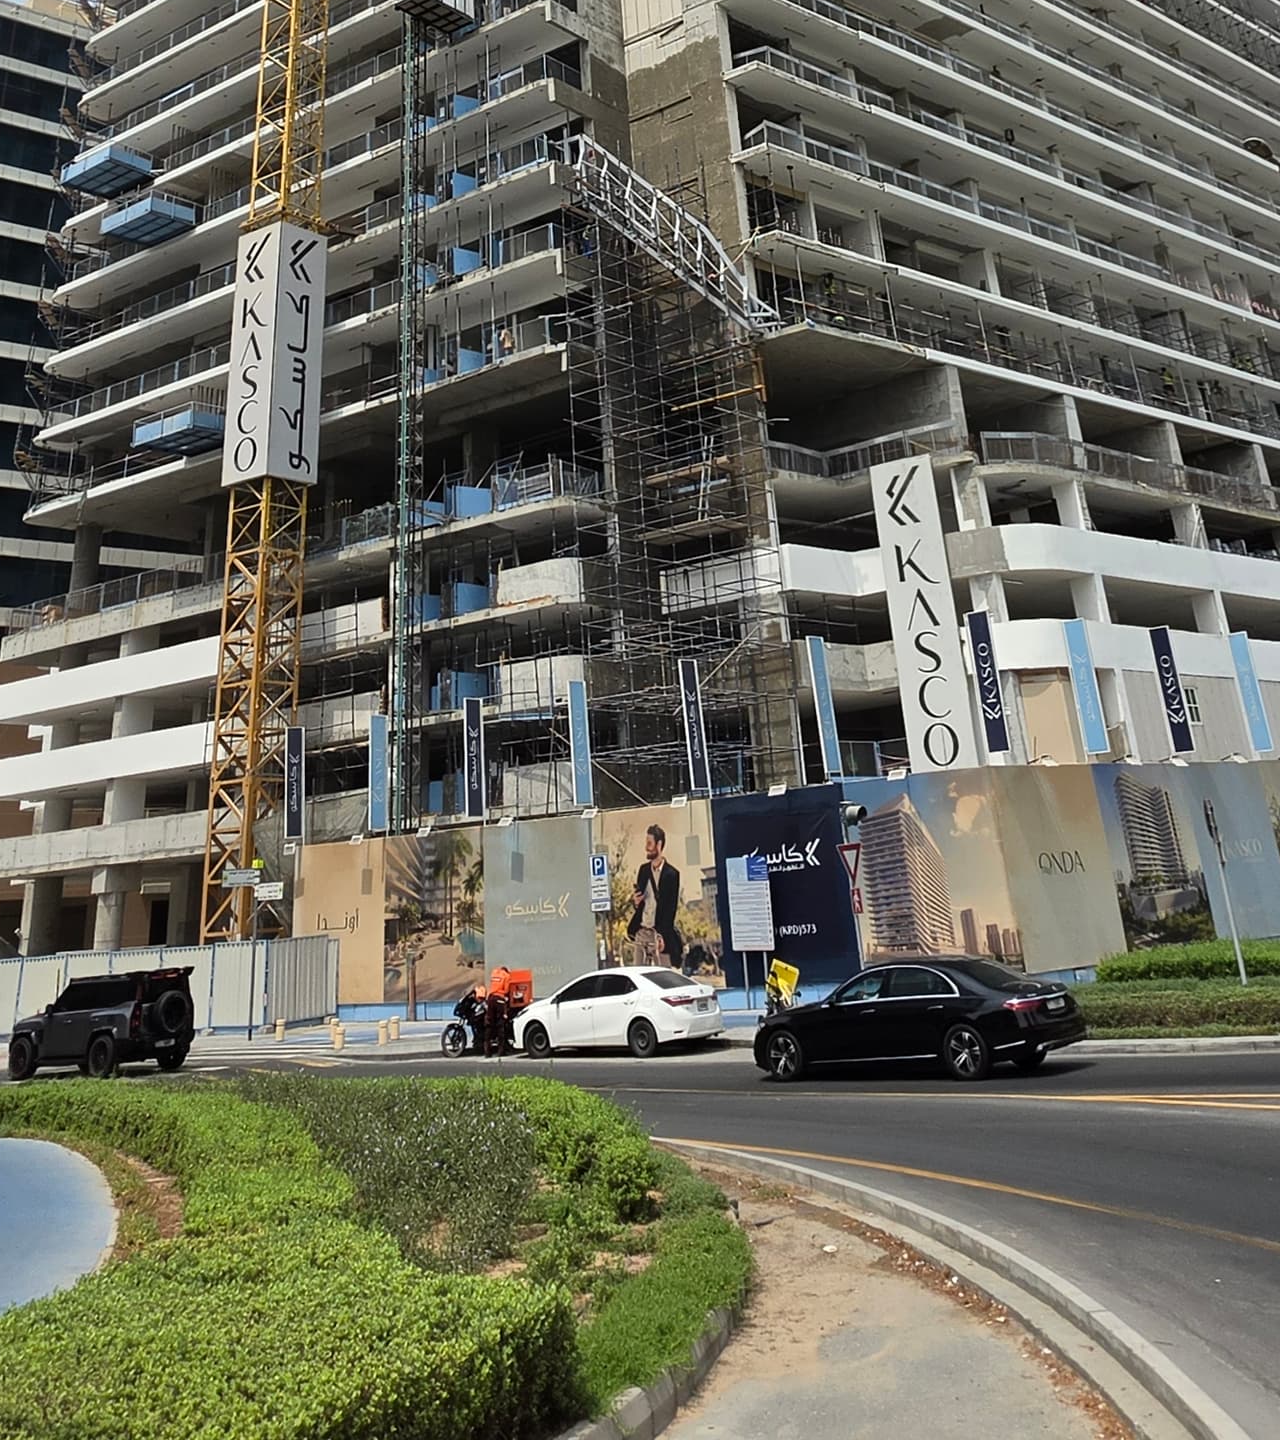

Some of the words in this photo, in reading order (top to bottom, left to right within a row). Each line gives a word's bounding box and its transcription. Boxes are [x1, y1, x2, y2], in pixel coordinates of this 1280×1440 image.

[233, 291, 269, 472] KASCO
[279, 291, 311, 474] كاسكو
[894, 538, 960, 767] KASCO
[977, 642, 997, 703] KASCO
[1159, 655, 1181, 710] KASCO
[689, 705, 701, 759] كاسكو
[290, 765, 298, 812] كاسكو
[470, 740, 479, 791] كاسكو
[741, 843, 804, 865] كاس
[1038, 850, 1086, 875] ONDA
[505, 895, 557, 920] كاسكو
